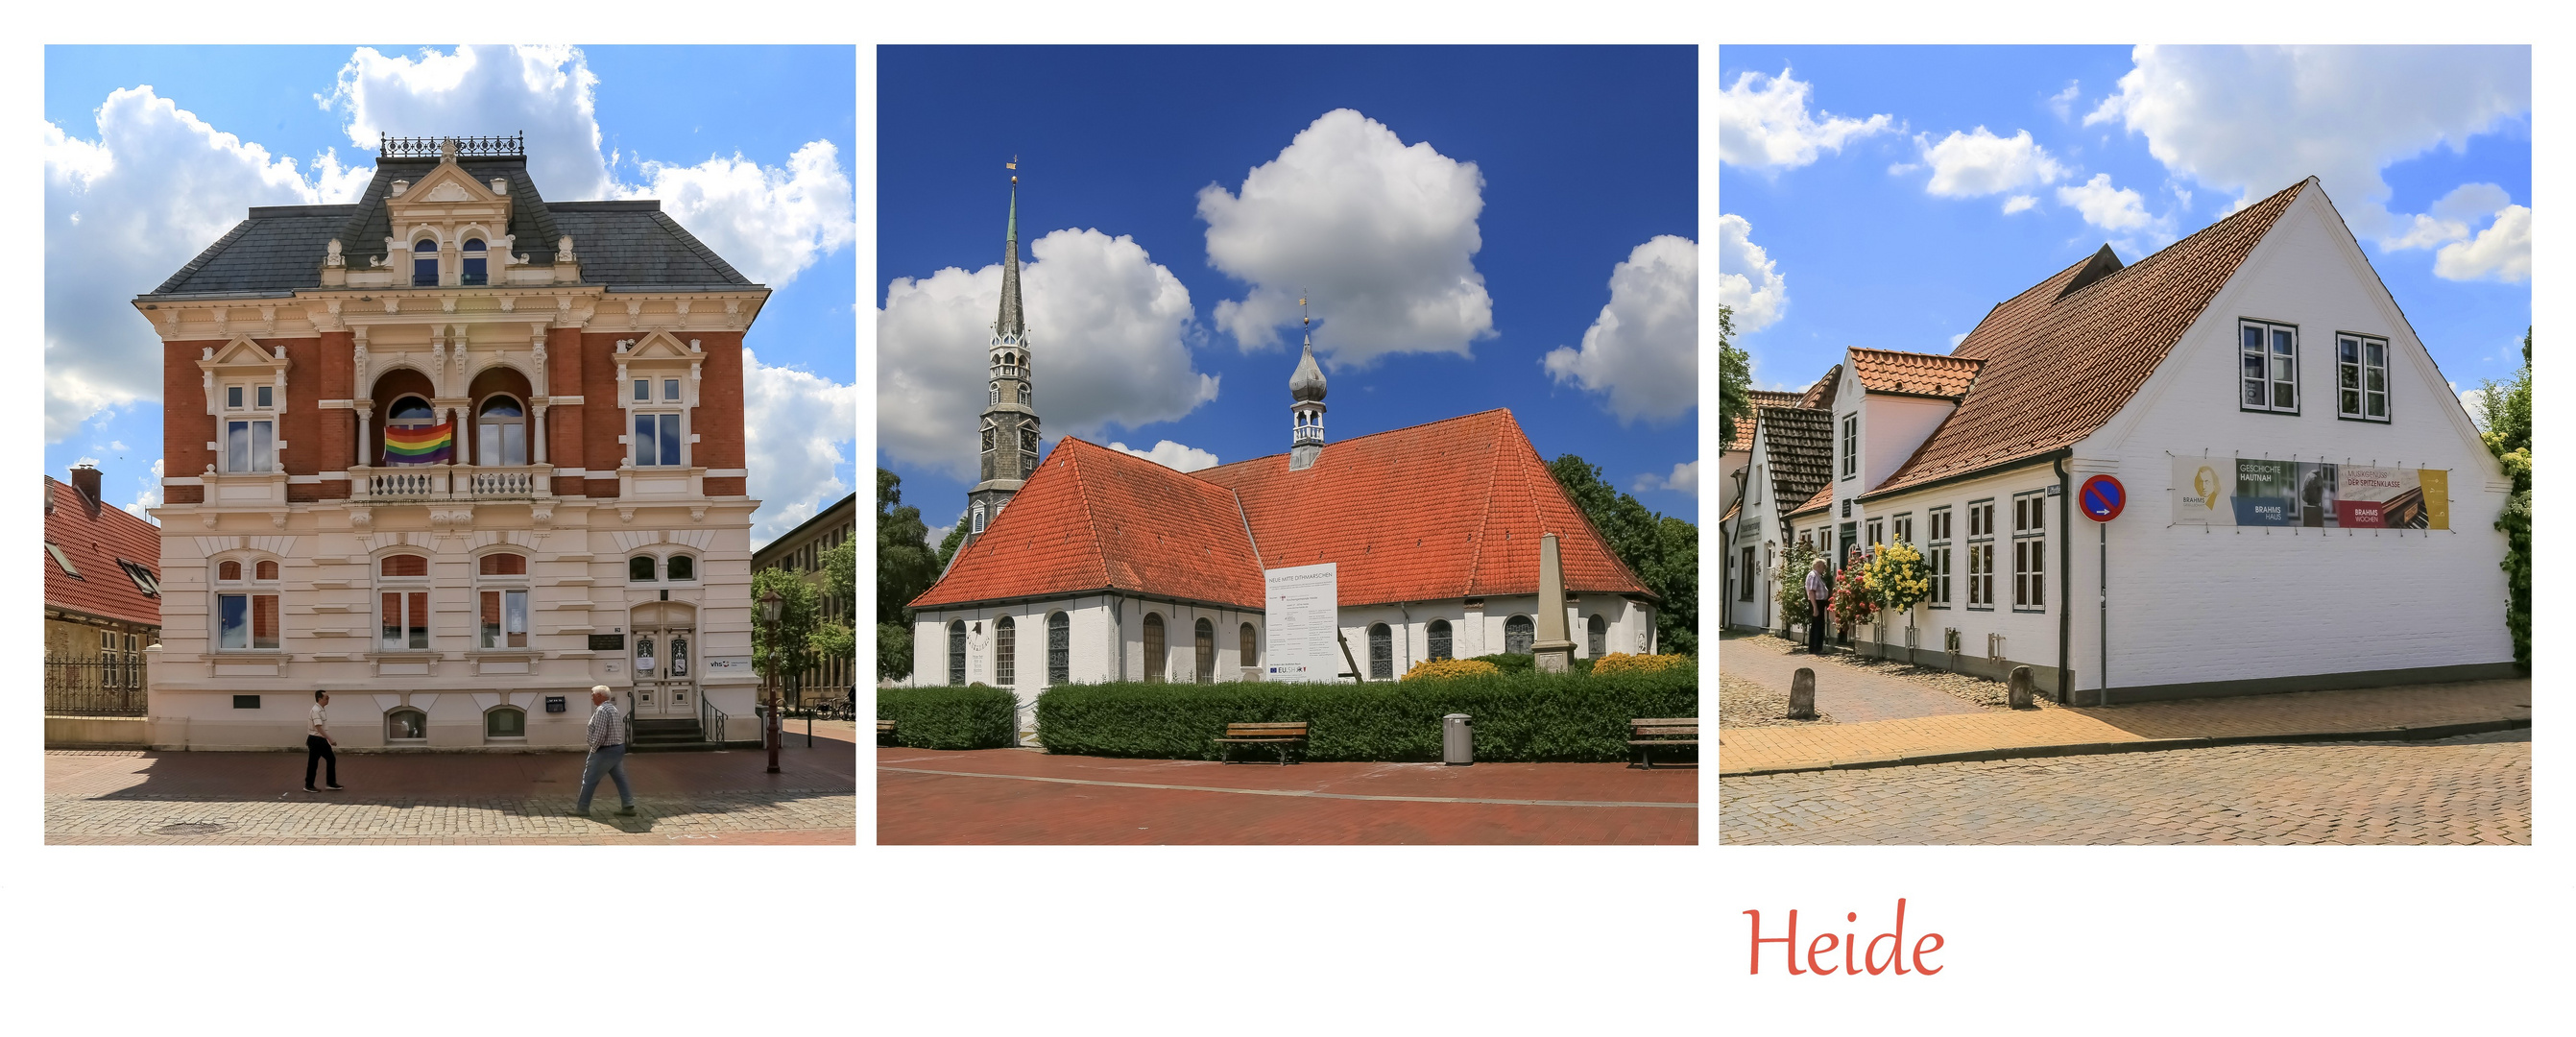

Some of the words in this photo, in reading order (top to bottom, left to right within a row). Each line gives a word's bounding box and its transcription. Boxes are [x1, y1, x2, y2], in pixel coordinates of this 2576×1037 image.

[2240, 464, 2281, 474] GESCHICHTE
[2240, 473, 2272, 482] HAUTNAH
[2347, 470, 2388, 479] MUSIKGENUSS
[2360, 479, 2400, 488] SPITZENKLASSE
[2254, 505, 2281, 514] BRAHMS
[2354, 508, 2378, 517] BRAHMS
[1295, 572, 1333, 581] DITHMARSCHEN
